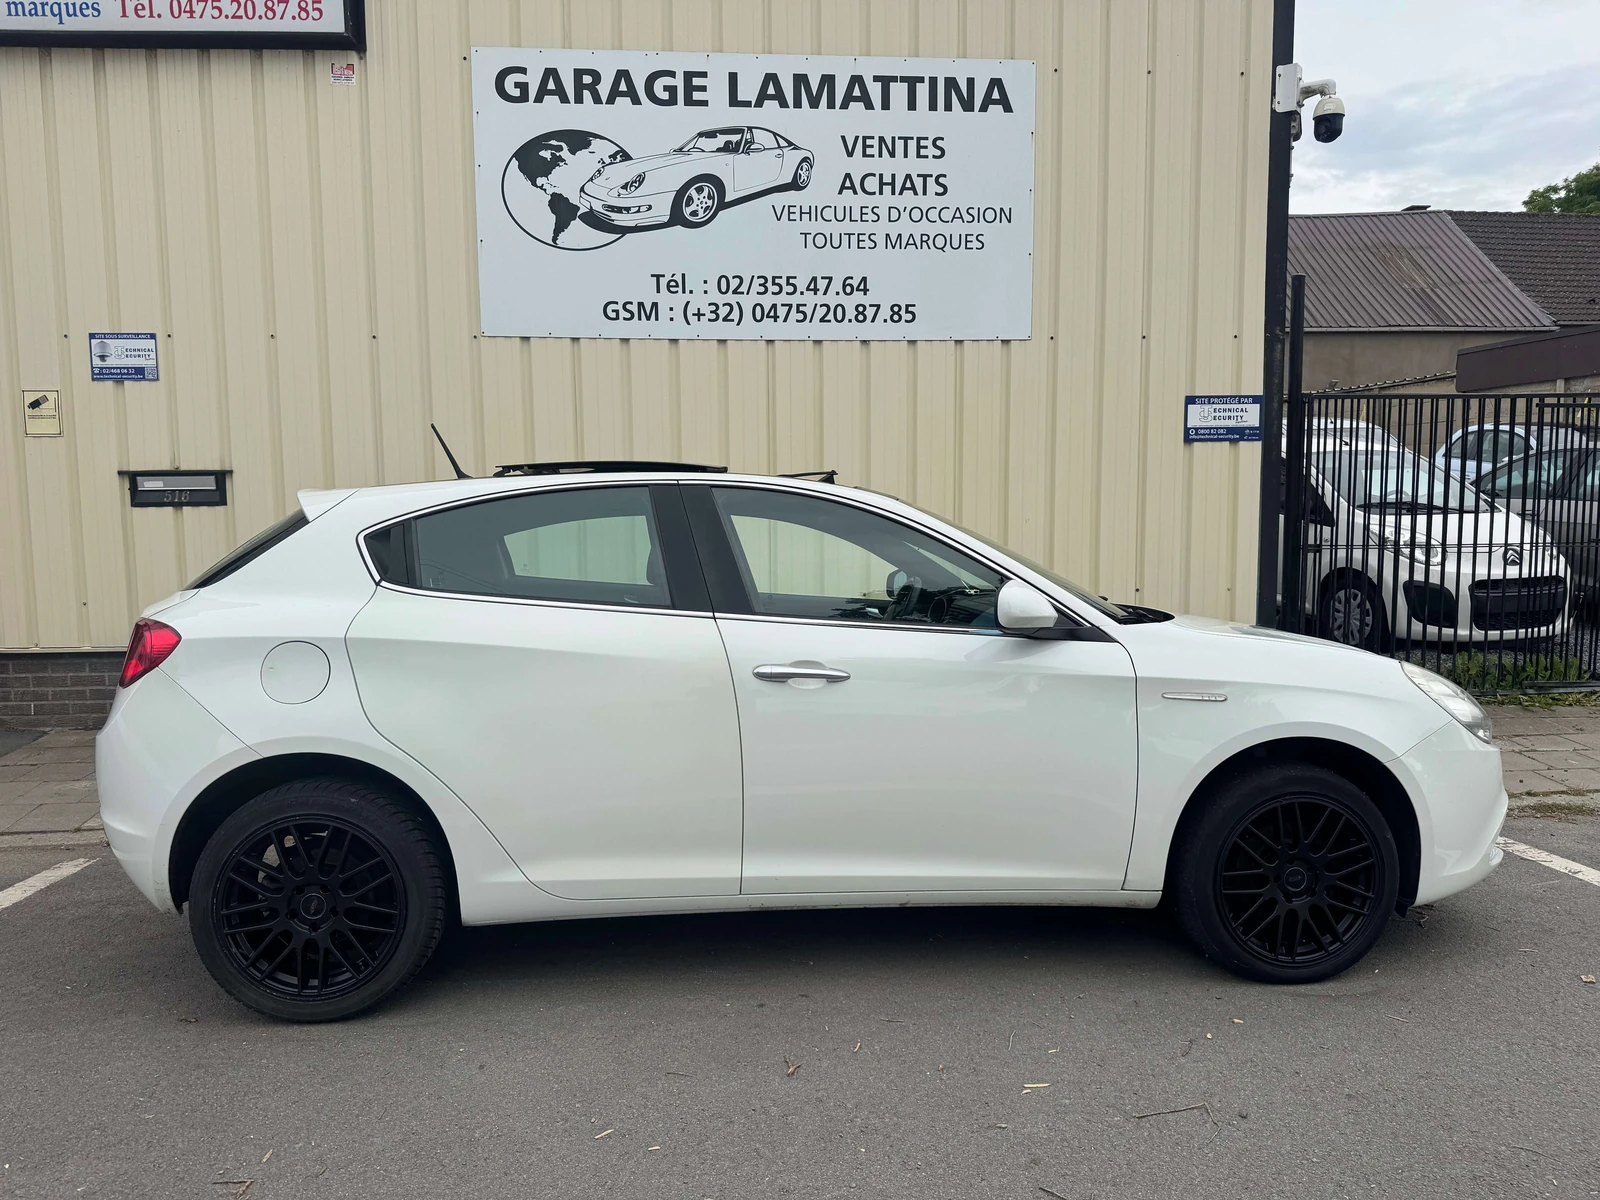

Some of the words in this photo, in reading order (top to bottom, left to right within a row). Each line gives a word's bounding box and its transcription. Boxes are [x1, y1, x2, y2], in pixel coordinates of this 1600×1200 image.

[5, 0, 102, 25] marques
[169, 0, 324, 21] 0475.20.87.85
[494, 66, 709, 107] GARAGE
[728, 71, 1014, 114] LAMATTINA
[840, 135, 946, 160] VENTES
[837, 172, 949, 197] ACHATS
[771, 204, 881, 223] VEHICULES
[799, 232, 878, 250] TOUTES
[885, 232, 985, 253] MARQUES
[650, 272, 694, 295] Tél.
[716, 274, 870, 297] 02/355.47.64
[602, 300, 659, 322] GSM
[682, 301, 744, 326] (+32)
[751, 302, 917, 324] 0475/20.87.85
[163, 490, 190, 502] 516
